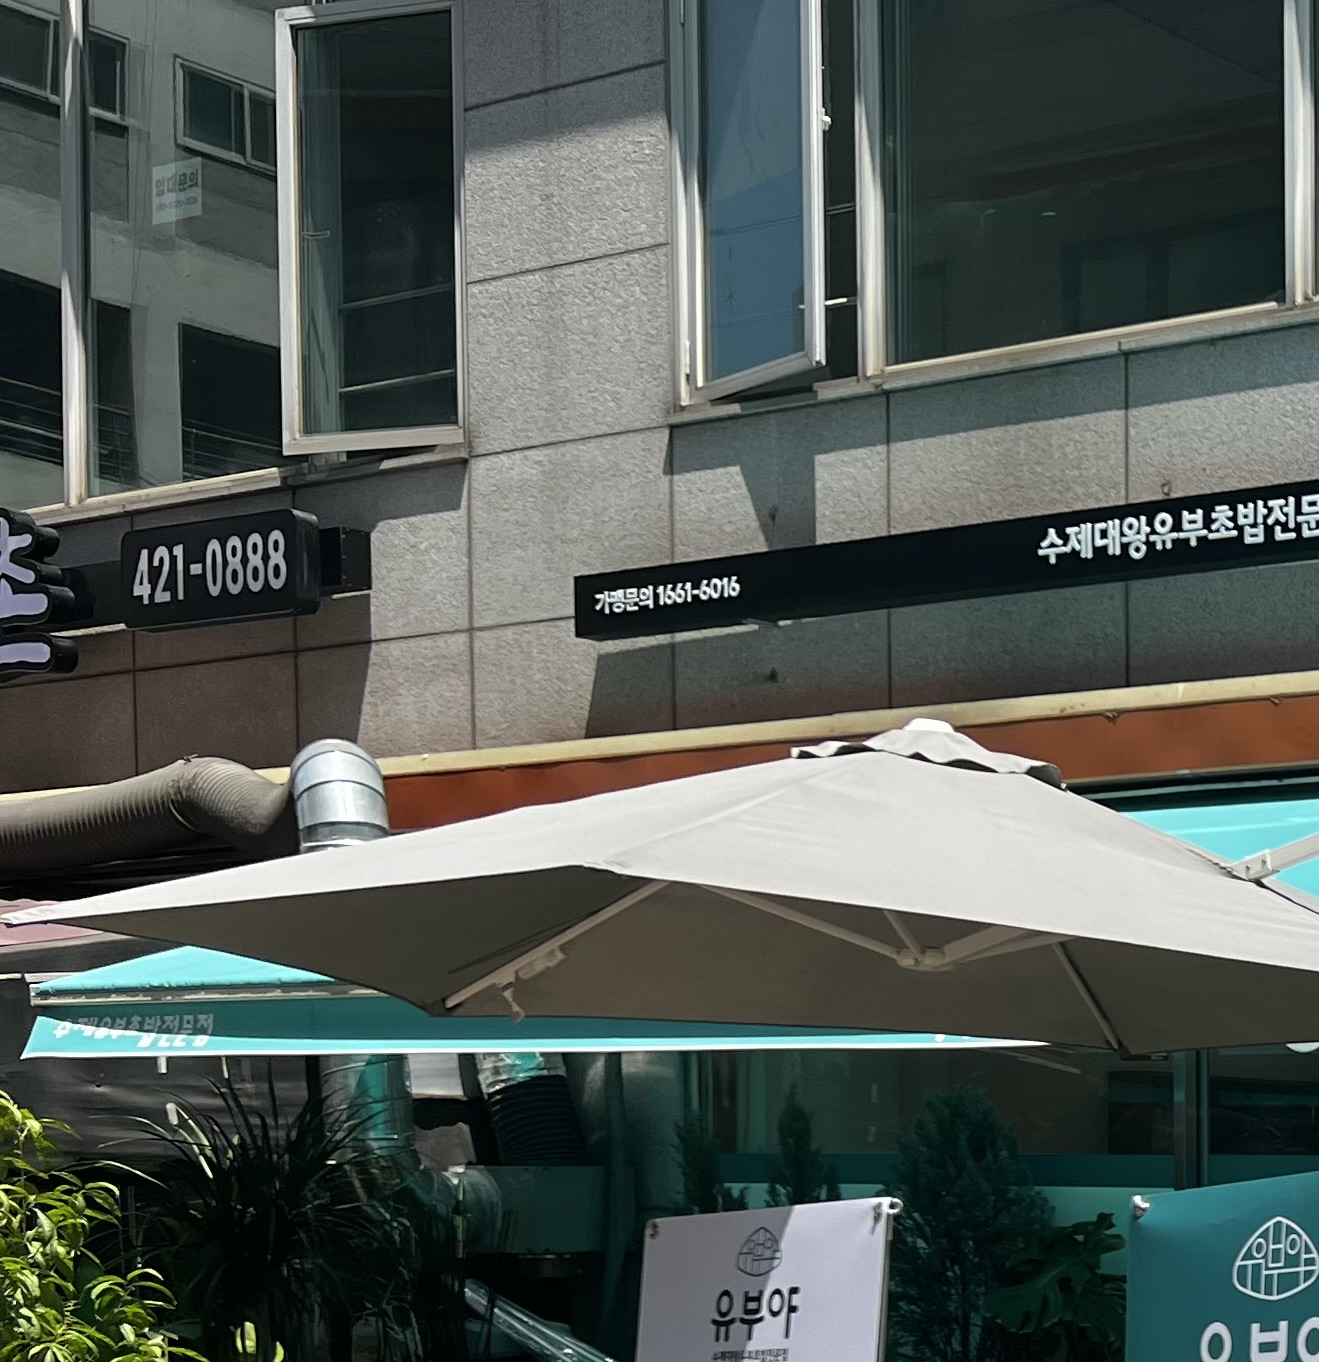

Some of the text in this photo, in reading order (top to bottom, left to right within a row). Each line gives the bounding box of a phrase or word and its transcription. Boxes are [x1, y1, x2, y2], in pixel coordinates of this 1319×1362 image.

[132, 528, 288, 605] 421-0888
[594, 575, 741, 614] 가맹문의 1661-6016
[710, 1286, 801, 1343] 유부야
